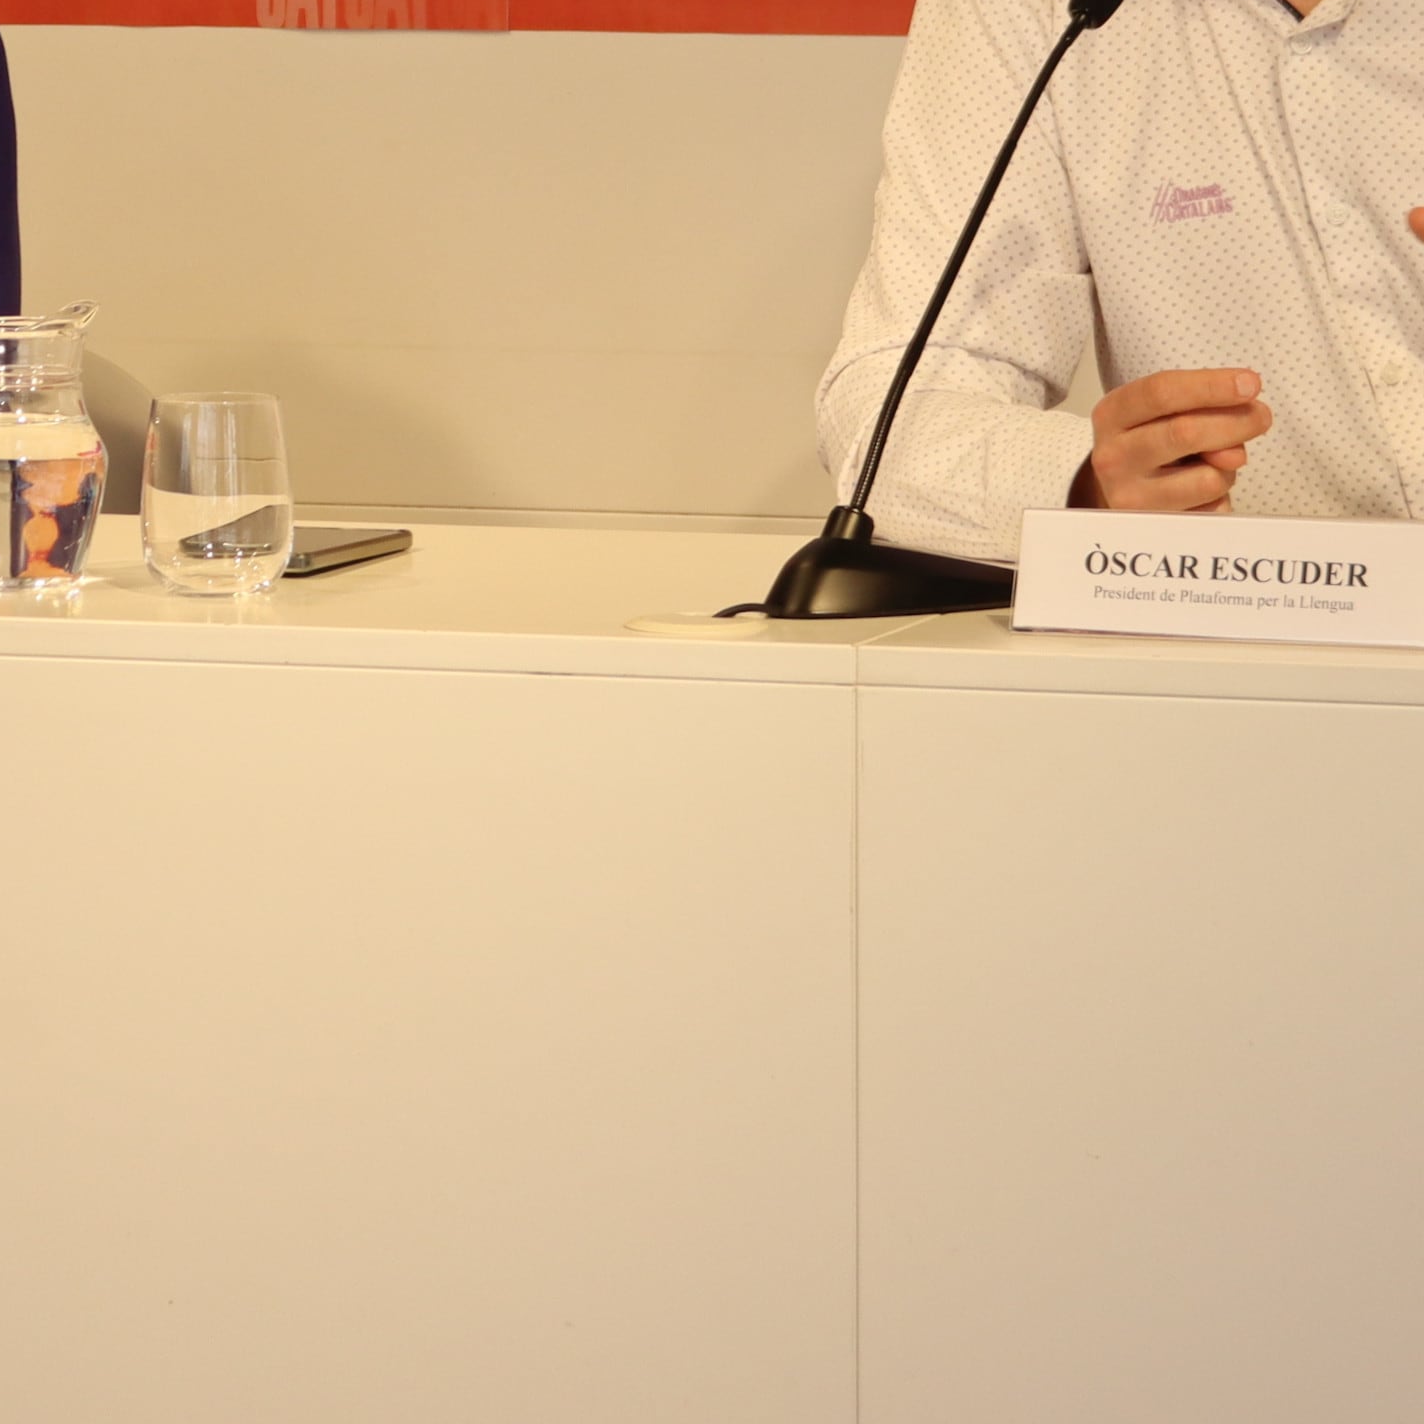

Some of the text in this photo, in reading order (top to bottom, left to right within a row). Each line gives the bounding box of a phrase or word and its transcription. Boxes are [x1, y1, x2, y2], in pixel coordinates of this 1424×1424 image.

[1085, 544, 1369, 588] ÒSCAR ESCUDER
[1093, 585, 1355, 612] President de Plataforma per la Llengua
